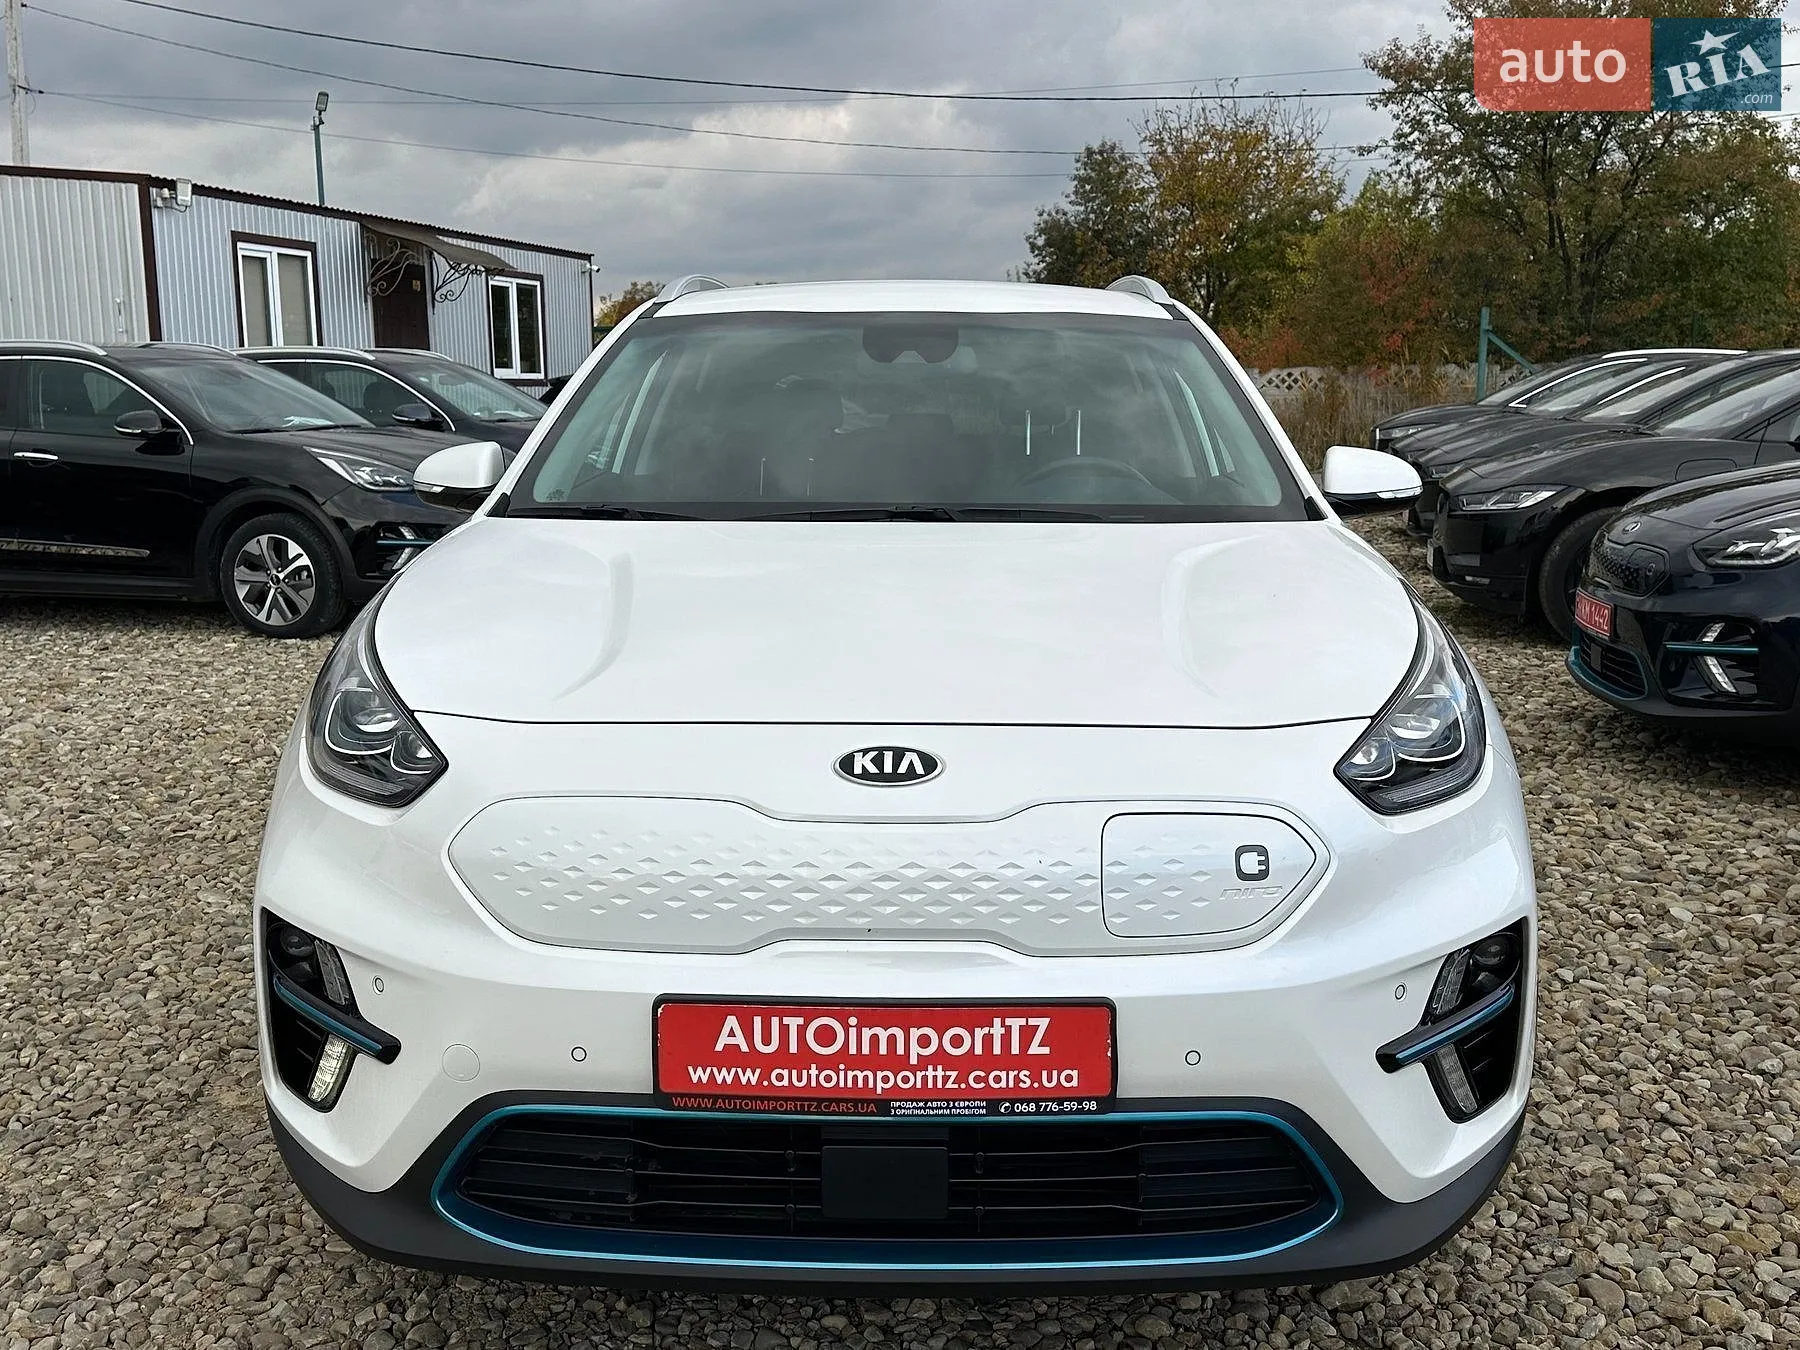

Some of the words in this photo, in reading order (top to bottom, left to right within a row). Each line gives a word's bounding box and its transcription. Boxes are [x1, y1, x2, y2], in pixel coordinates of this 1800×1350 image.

[853, 750, 926, 775] KIA
[714, 1015, 1052, 1064] AUTOimportTZ
[688, 1063, 1079, 1094] www.autoimporttz.cars.ua
[672, 1096, 877, 1113] WWW.AUTOIMPORTTZ.CARS.UA
[1014, 1102, 1036, 1113] 068
[1039, 1101, 1097, 1112] 776-59-98
